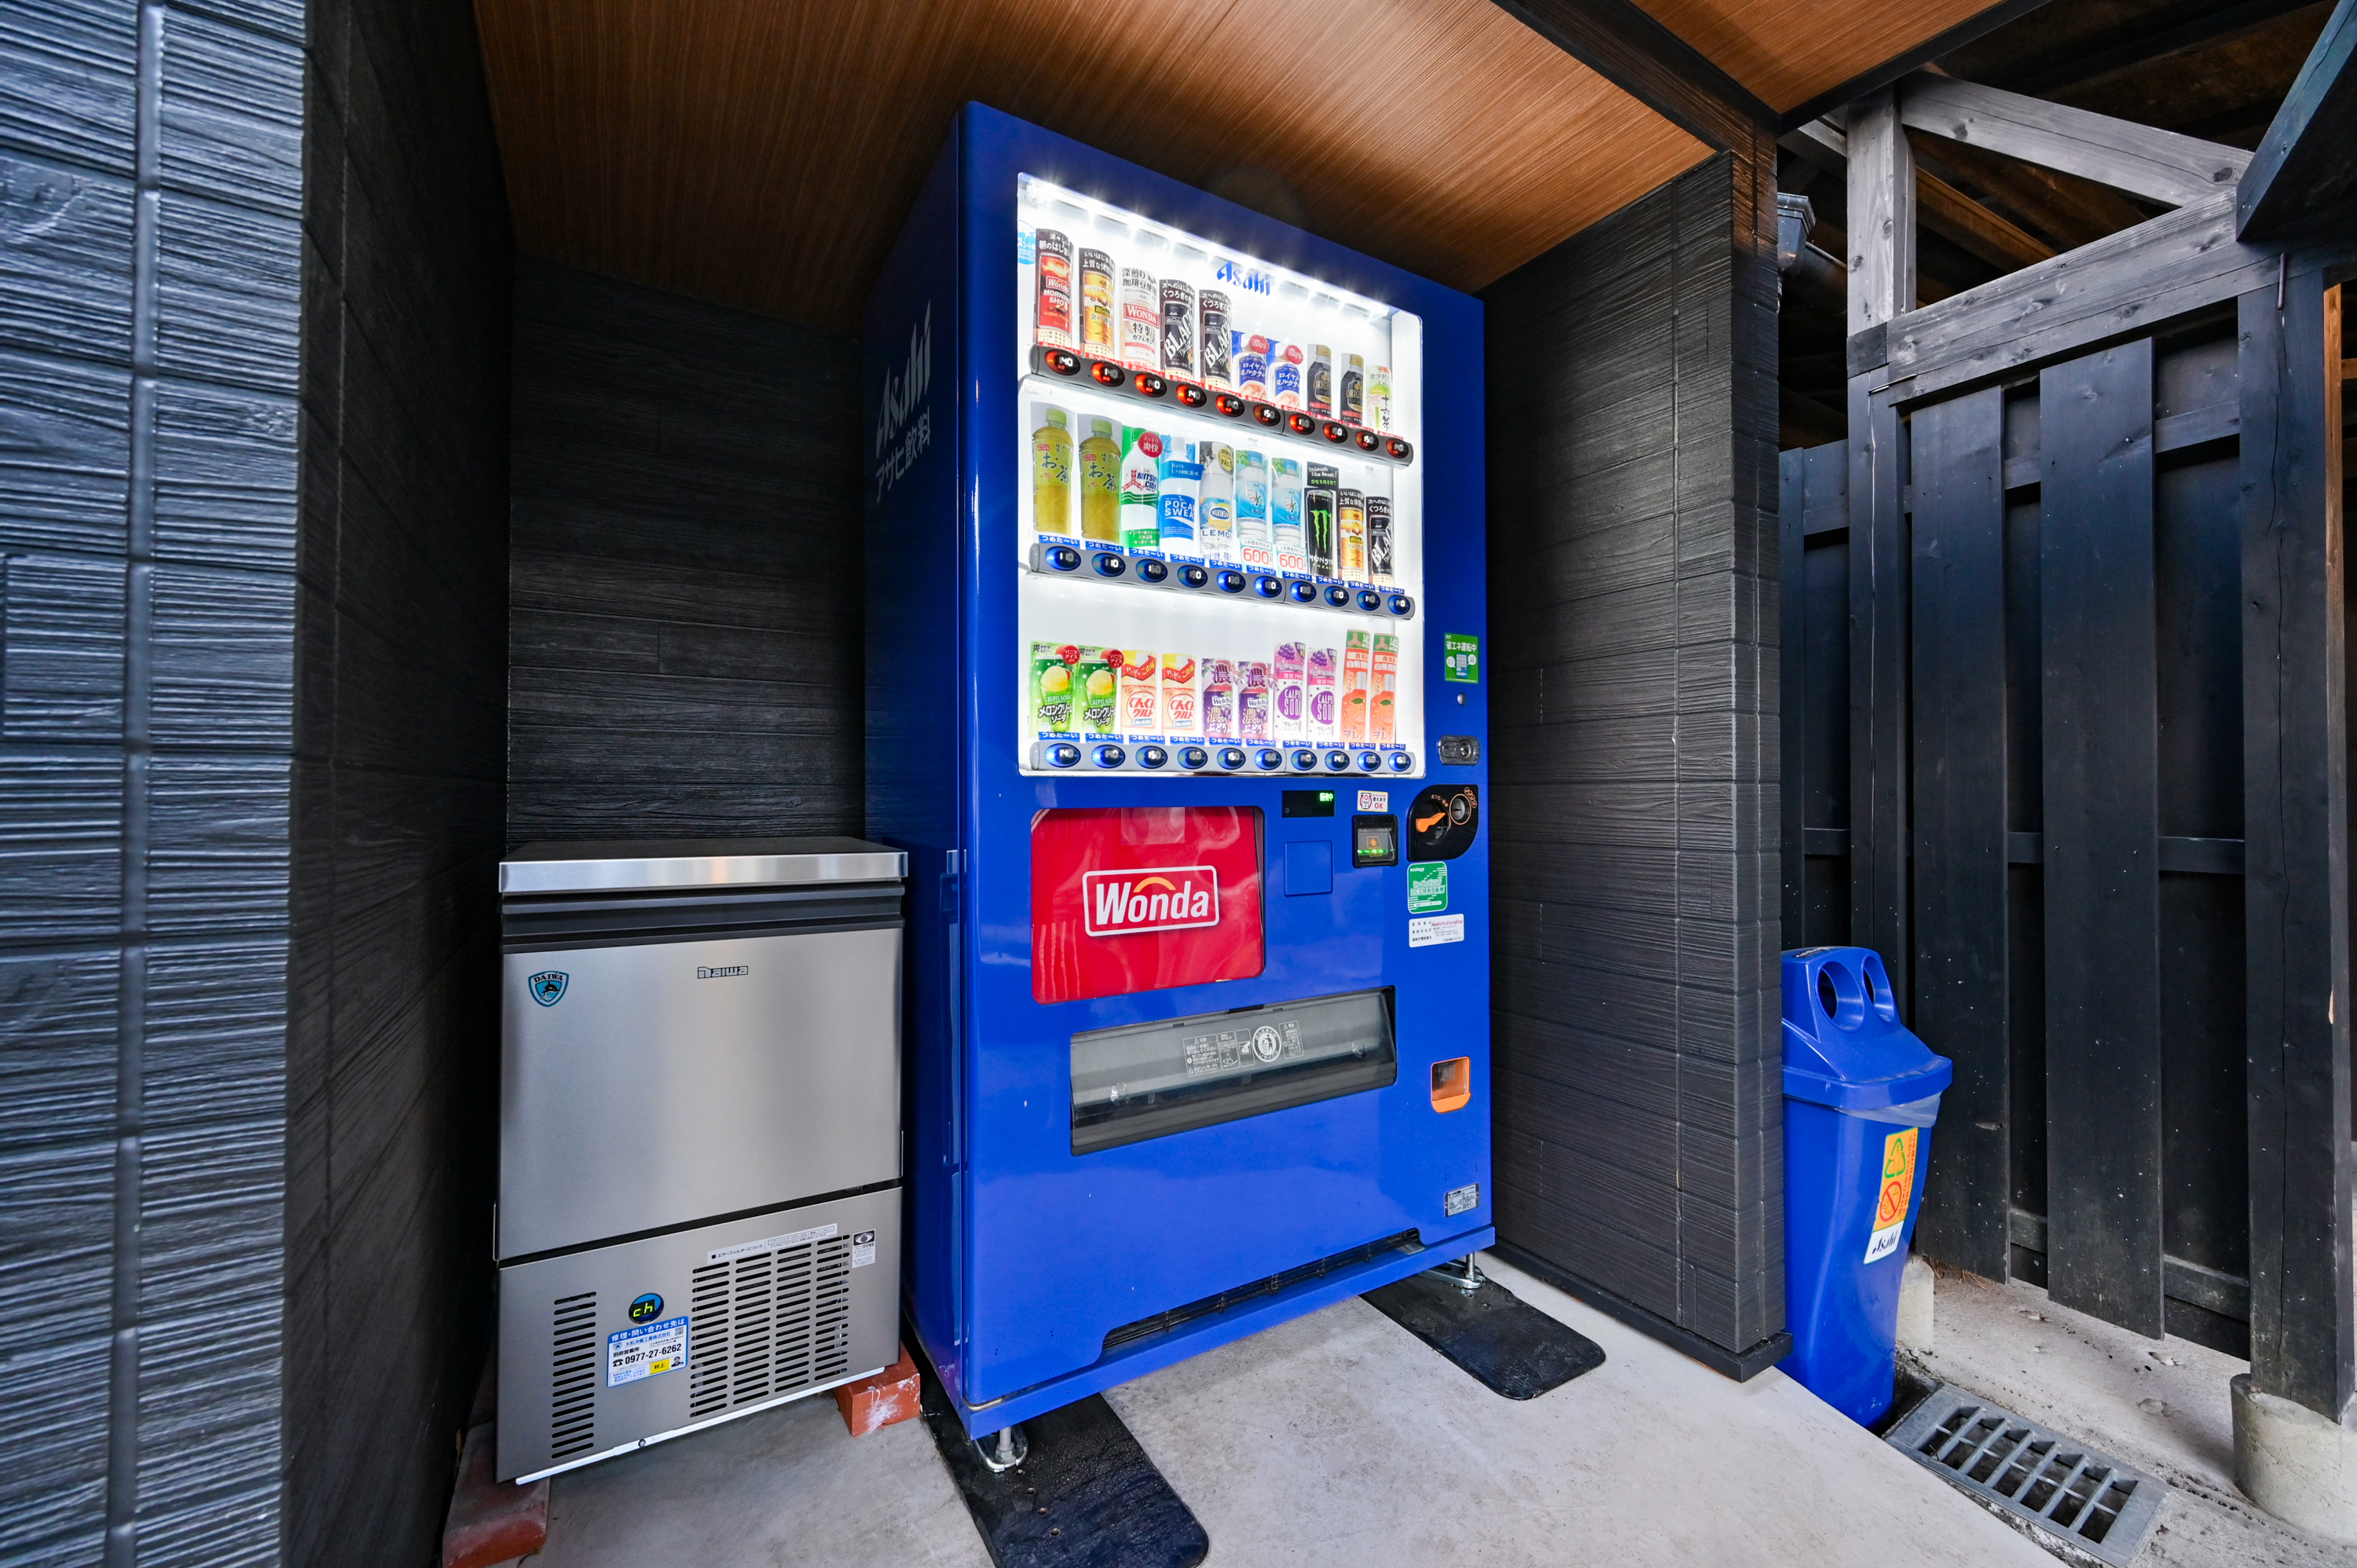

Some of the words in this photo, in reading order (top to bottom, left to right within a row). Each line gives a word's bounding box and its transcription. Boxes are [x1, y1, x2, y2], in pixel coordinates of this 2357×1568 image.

[1122, 268, 1146, 279] 深煎り
[1216, 260, 1270, 296] Asahi
[1043, 289, 1070, 302] MORNIN
[1125, 304, 1157, 324] WONDA
[1164, 310, 1193, 361] BLAC
[1059, 356, 1073, 367] 140
[1242, 362, 1266, 371] ロイヤル
[1104, 368, 1118, 379] 140
[876, 299, 930, 459] Asahi
[1147, 380, 1160, 390] 140
[1188, 390, 1200, 399] 140
[1226, 400, 1239, 409] 140
[1263, 409, 1274, 419] 150
[1299, 419, 1309, 427] 150
[1332, 427, 1343, 436] 150
[1364, 435, 1373, 444] 150
[1142, 441, 1159, 453] 爽快
[876, 406, 930, 504] アサヒ飲料
[1164, 507, 1194, 519] SWEA
[1201, 529, 1232, 539] LEMO
[1060, 552, 1074, 562] 110
[1243, 548, 1269, 565] 600
[1105, 559, 1119, 568] 110
[1279, 554, 1304, 571] 600
[1149, 565, 1161, 573] 160
[1228, 576, 1240, 584] 130
[1446, 640, 1477, 653] 省エネ運転中
[1132, 709, 1153, 718] グルト
[1173, 710, 1193, 720] グルト
[1051, 714, 1067, 724] ソーダ
[1096, 716, 1111, 727] ソーダ
[1207, 723, 1228, 733] ぶどう
[1242, 724, 1263, 735] ぶどう
[1059, 749, 1074, 758] 140
[1105, 749, 1119, 758] 140
[1148, 750, 1161, 759] 150
[1189, 751, 1202, 760] 150
[1228, 752, 1240, 760] 150
[1265, 753, 1277, 761] 150
[1096, 881, 1209, 925] Wonda
[533, 973, 563, 983] DAIWA
[1872, 1229, 1899, 1255] Asahi
[632, 1302, 653, 1317] ch
[611, 1318, 685, 1343] 修理・問い合わせ先は
[625, 1343, 682, 1365] 0977-27-6262
